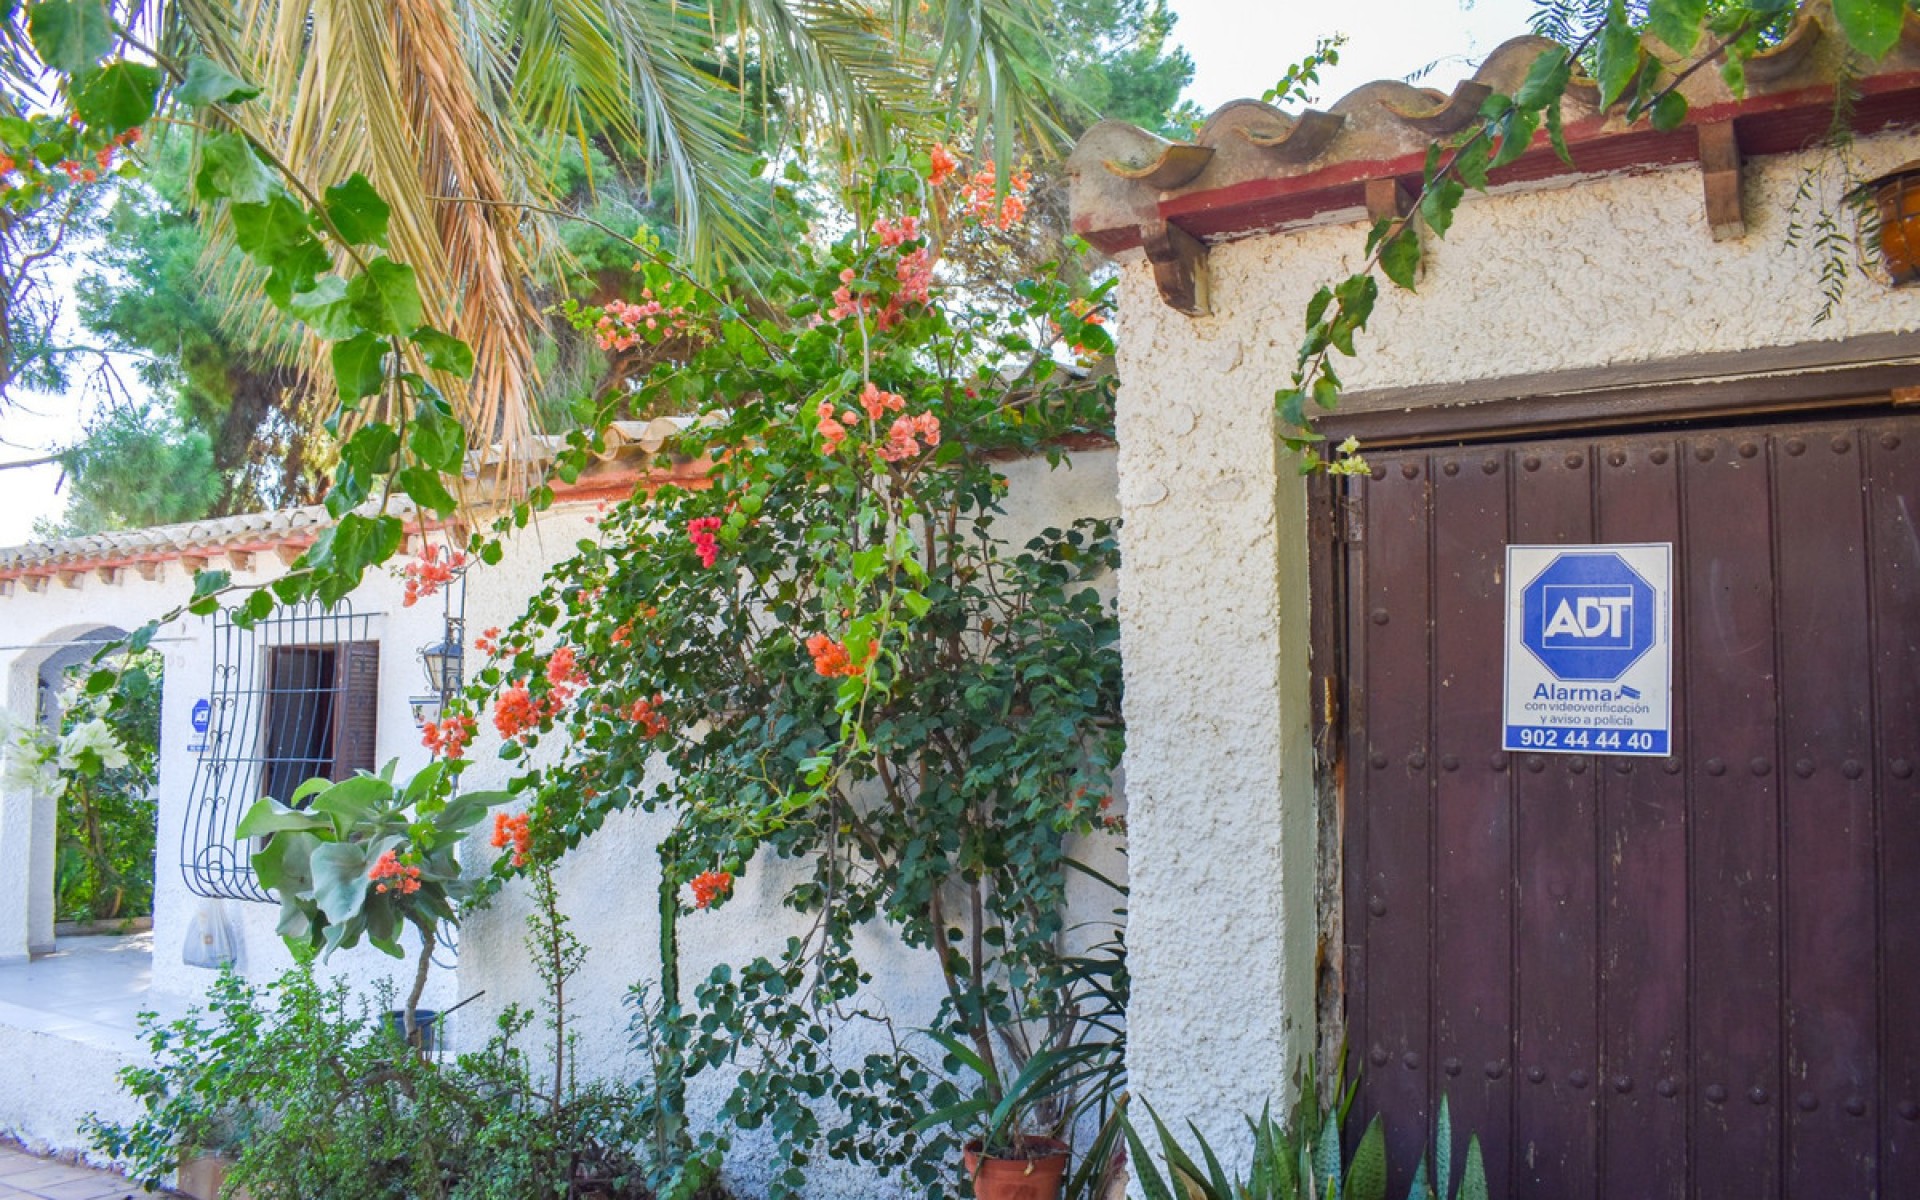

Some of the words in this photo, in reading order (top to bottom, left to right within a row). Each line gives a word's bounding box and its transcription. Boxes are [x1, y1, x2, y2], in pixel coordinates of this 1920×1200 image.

[1543, 597, 1632, 638] ADT
[1533, 683, 1612, 701] Alarma
[1524, 702, 1547, 711] con
[1549, 702, 1649, 714] videoverificación
[1540, 715, 1547, 726] y
[1550, 714, 1581, 724] aviso
[1583, 716, 1591, 725] a
[1594, 714, 1633, 727] policía
[1520, 728, 1558, 747] 902
[1564, 730, 1589, 748] 44
[1595, 731, 1621, 749] 44
[1626, 732, 1652, 750] 40
